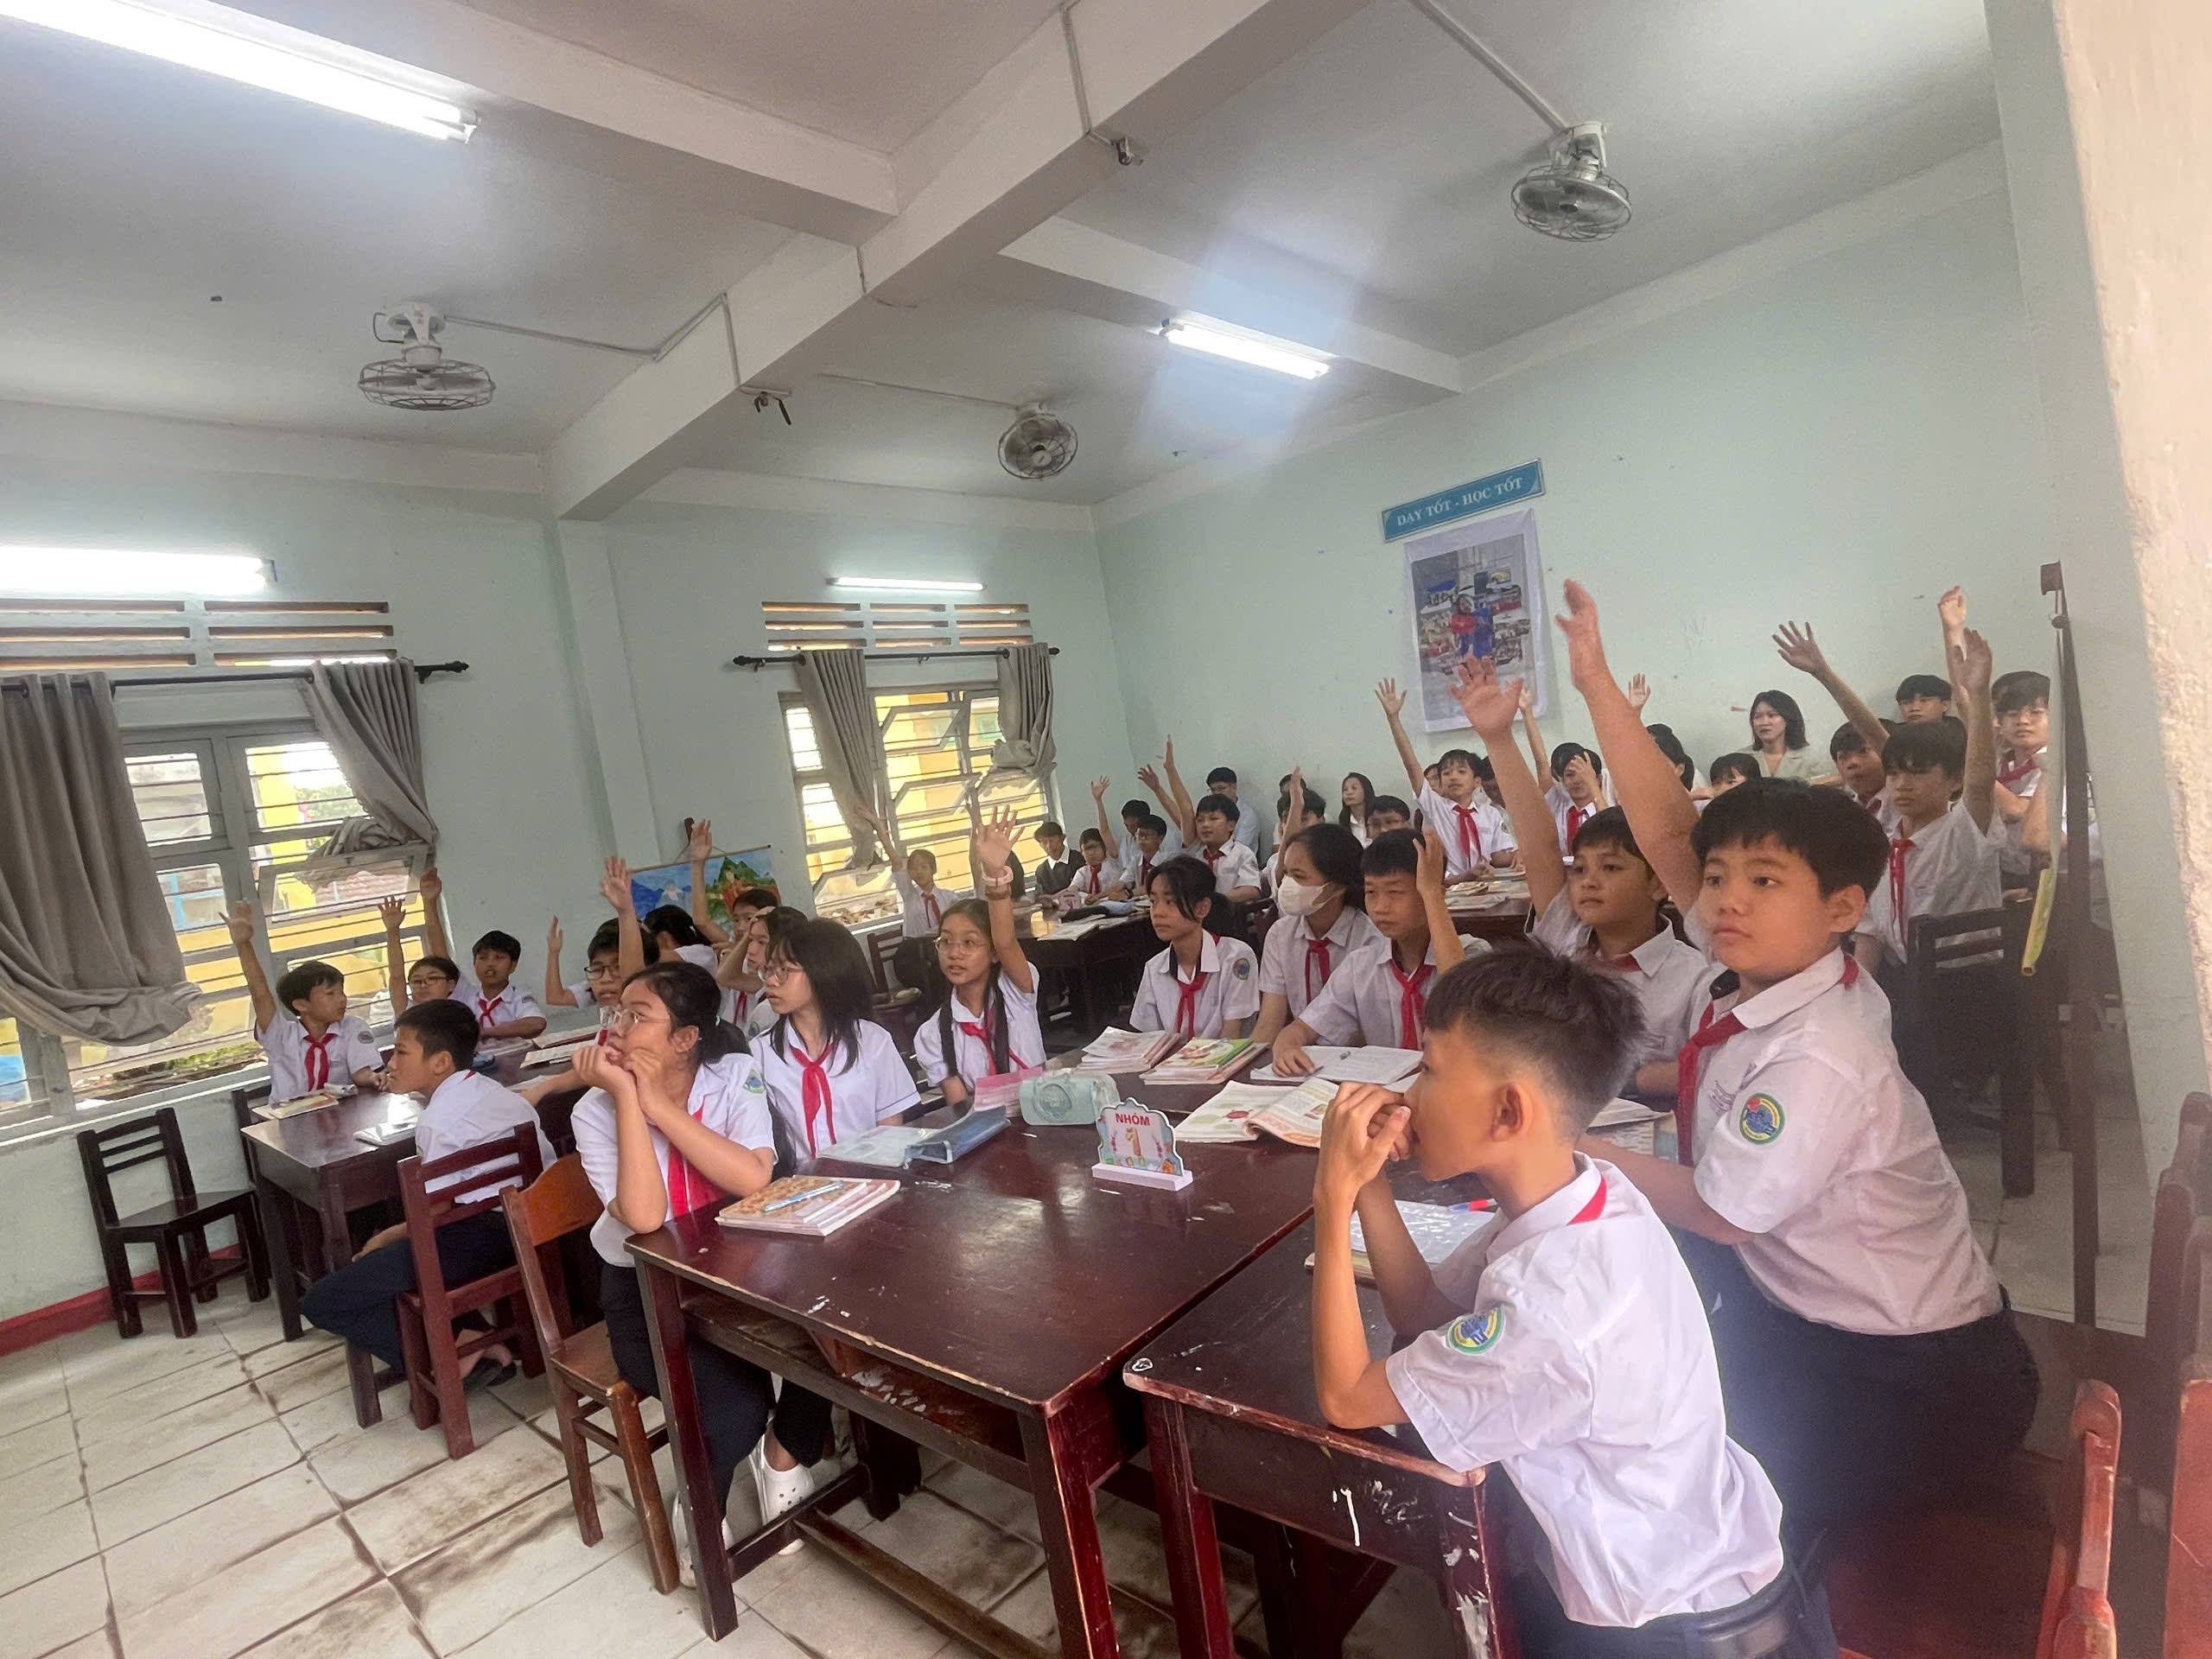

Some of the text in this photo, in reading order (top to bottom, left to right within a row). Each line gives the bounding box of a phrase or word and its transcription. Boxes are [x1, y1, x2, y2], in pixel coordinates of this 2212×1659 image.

[1426, 498, 1451, 517] TỐT
[1463, 488, 1491, 505] HỌC
[1494, 476, 1522, 495] TỐT
[1115, 1112, 1150, 1126] NHÓM
